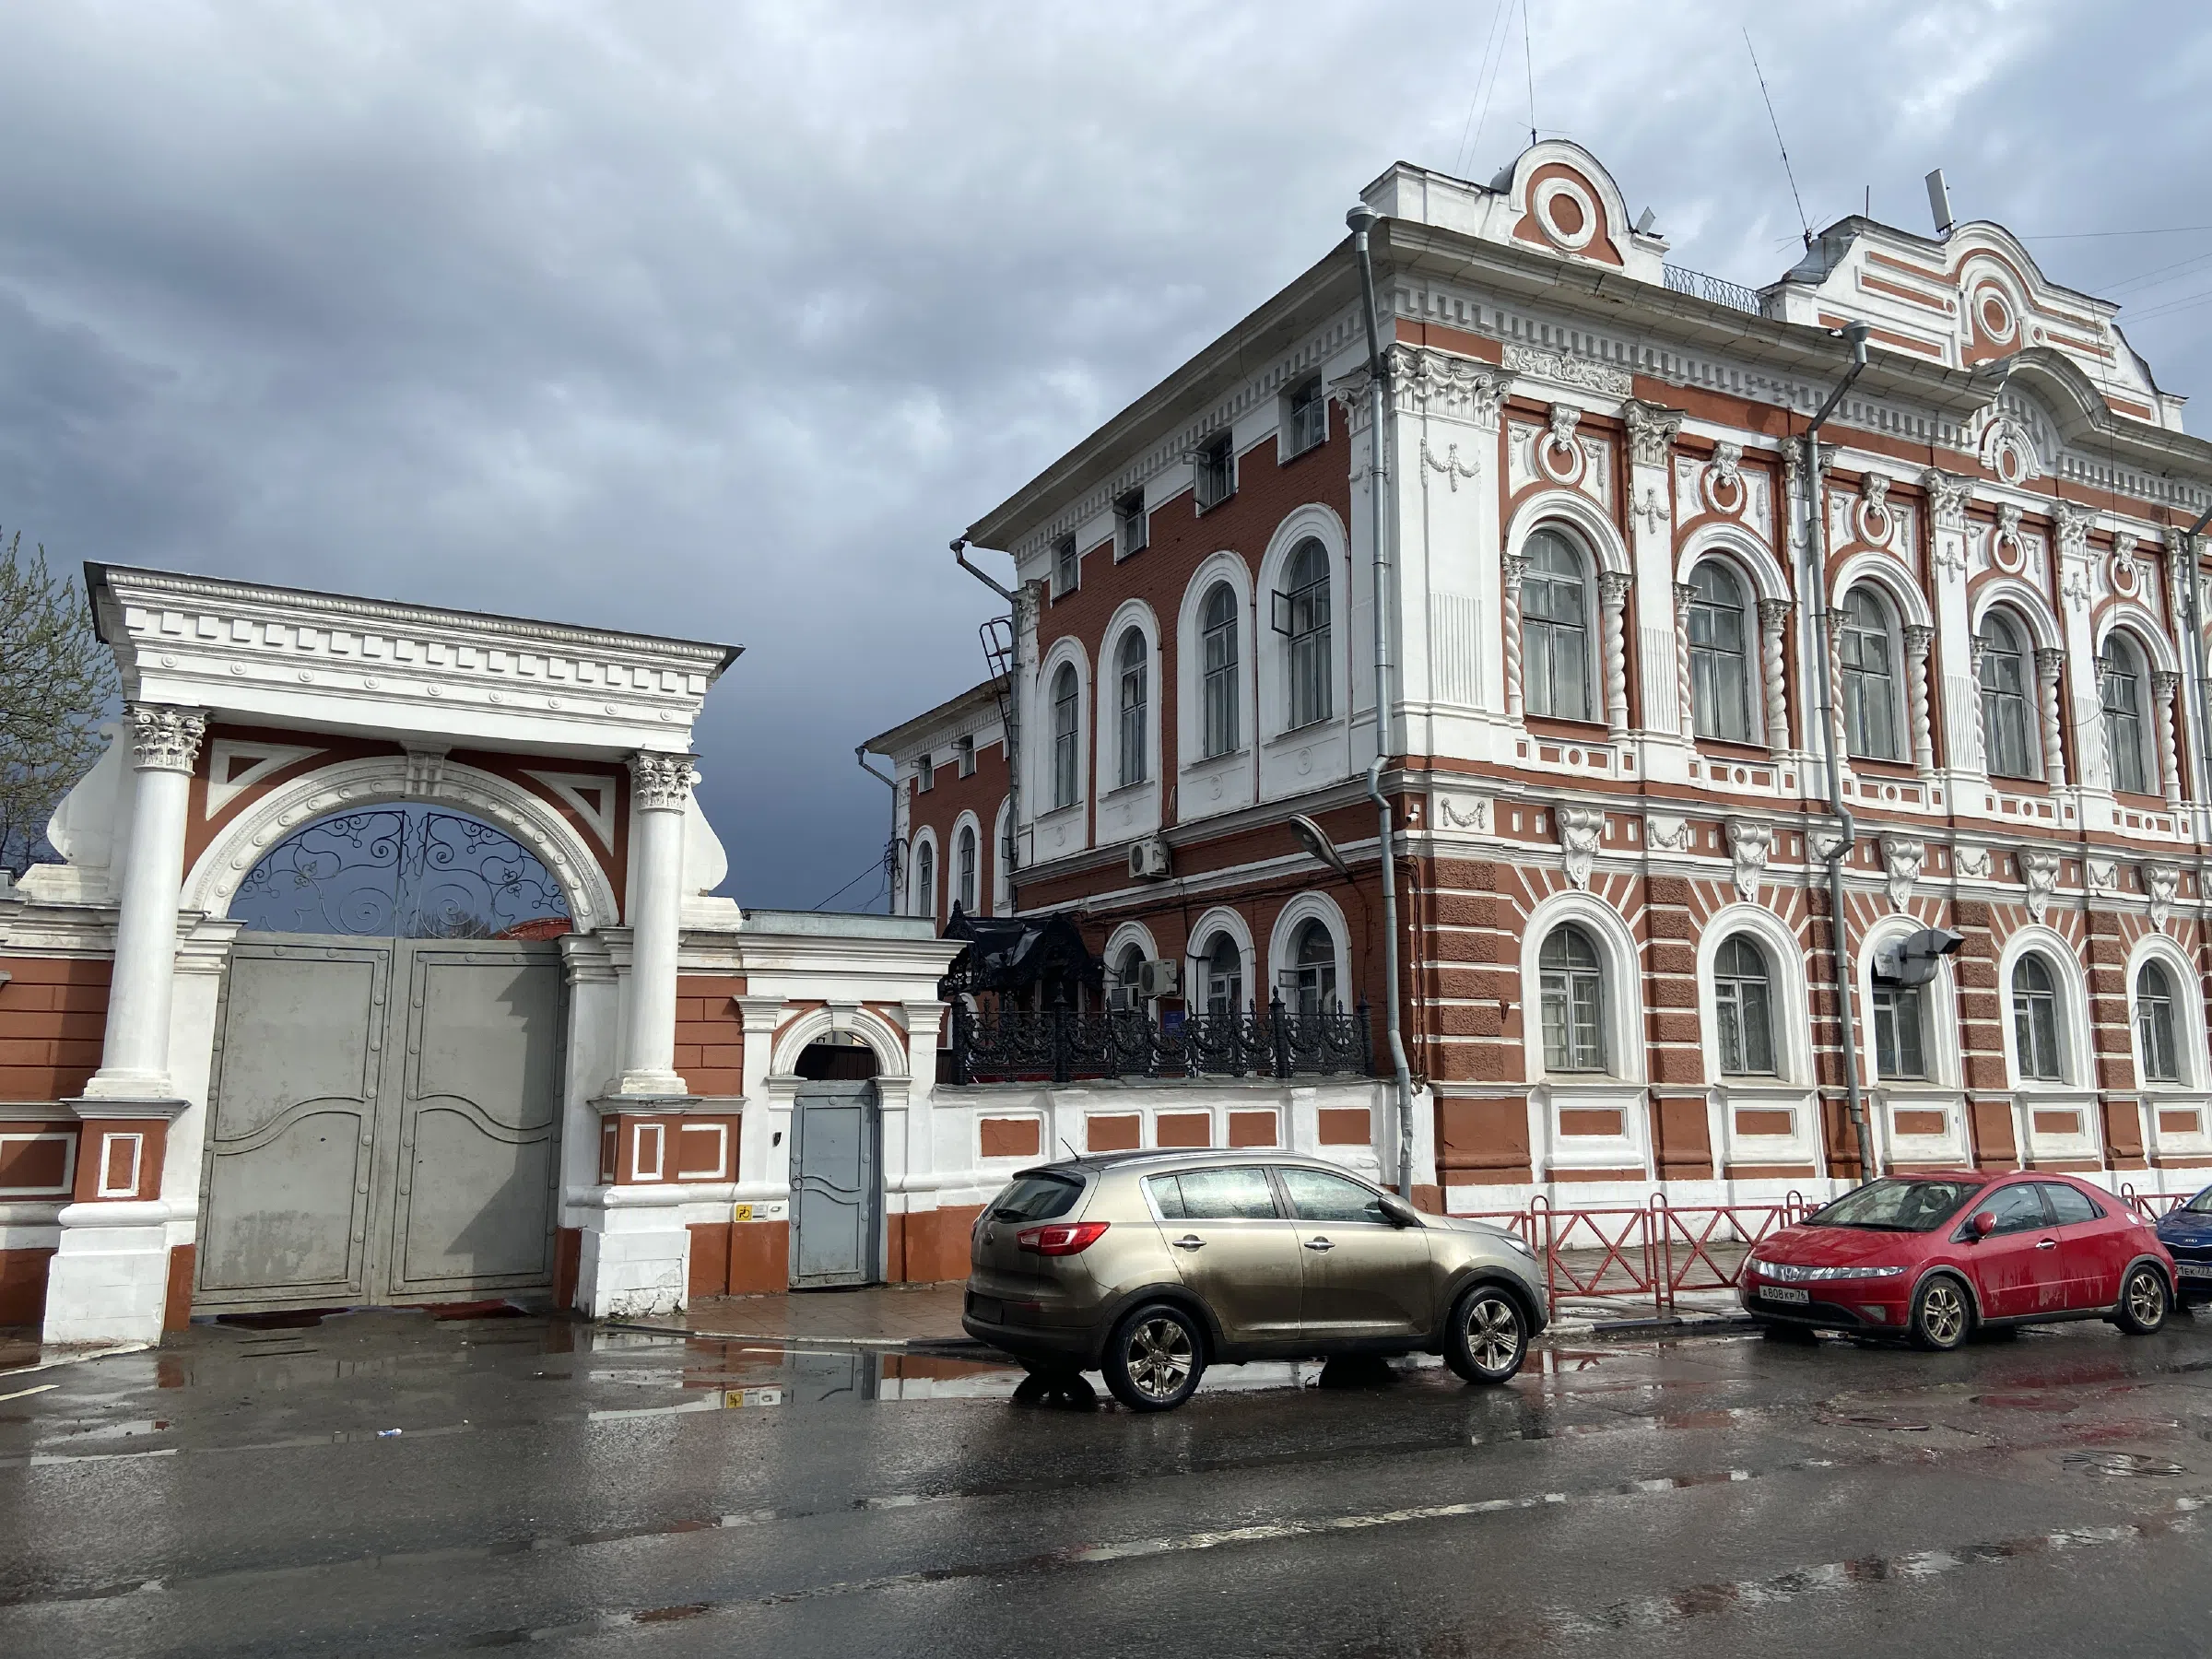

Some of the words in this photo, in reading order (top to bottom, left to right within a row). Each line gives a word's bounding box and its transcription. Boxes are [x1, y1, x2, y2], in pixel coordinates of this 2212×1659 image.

[2175, 1265, 2195, 1276] 21ЕК
[2197, 1266, 2209, 1275] 777
[1796, 1290, 1806, 1300] 76
